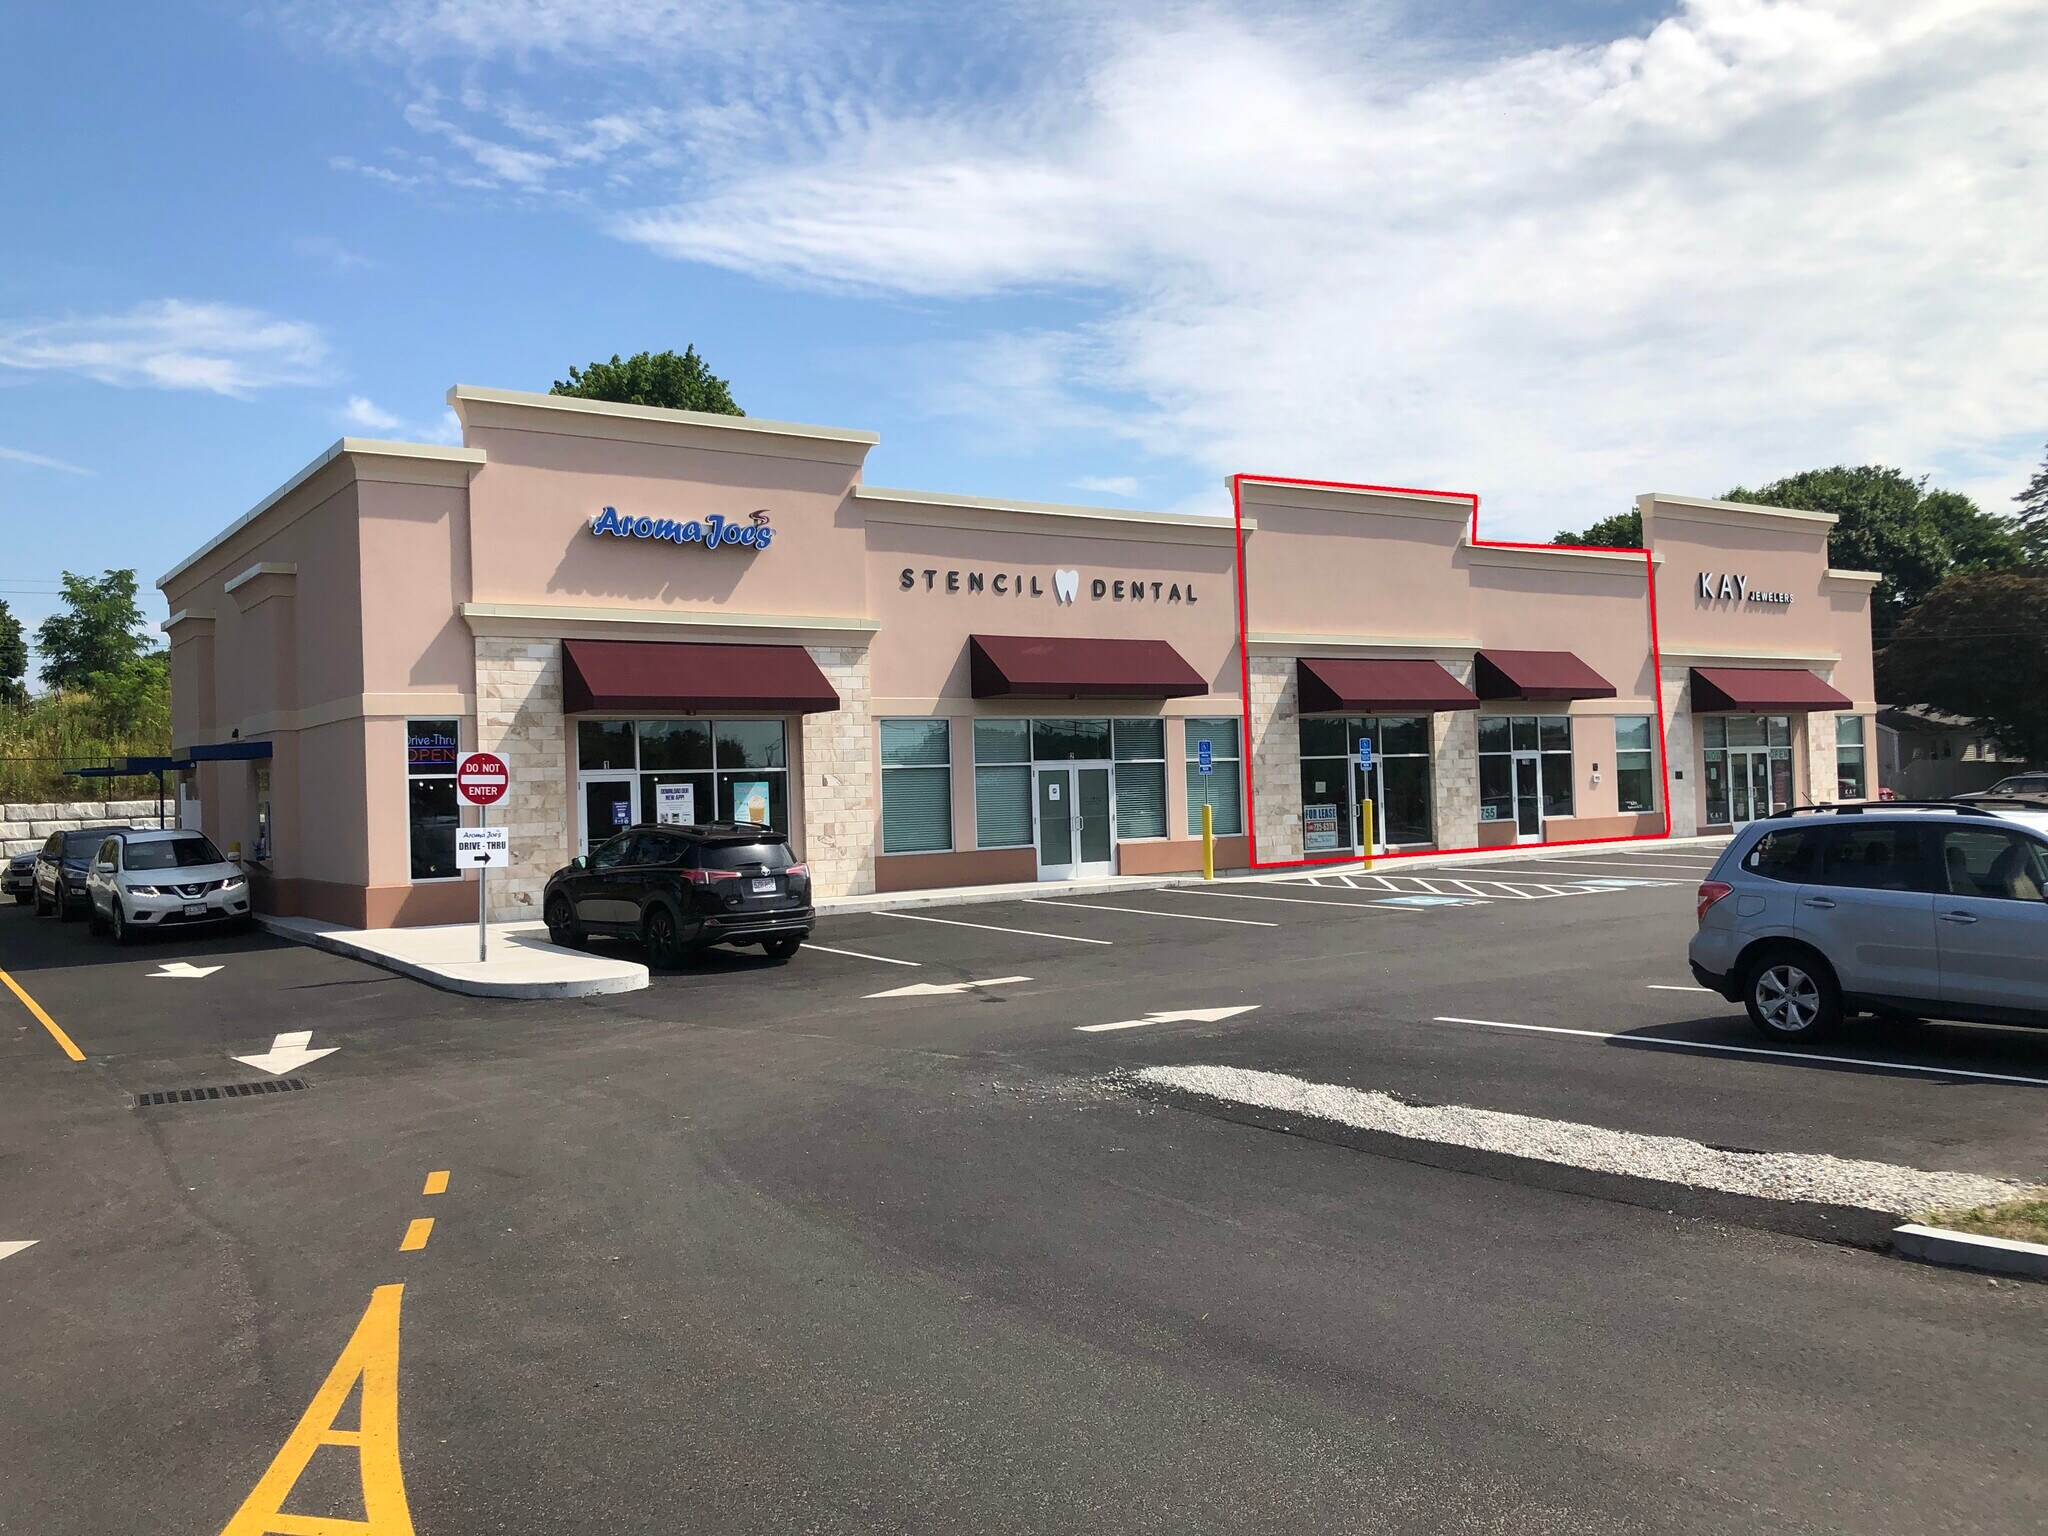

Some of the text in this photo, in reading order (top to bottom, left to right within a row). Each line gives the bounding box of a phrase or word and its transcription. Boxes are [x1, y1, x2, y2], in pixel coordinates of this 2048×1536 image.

[593, 506, 703, 544] Aroma
[901, 568, 1198, 602] STENCIL DENTAL
[1699, 572, 1795, 603] KAY JEWELERS
[408, 749, 456, 762] OPEN
[466, 763, 500, 773] DO NOT
[468, 786, 498, 796] ENTER
[1305, 808, 1336, 820] FOR LEASE
[1480, 807, 1495, 819] 755
[463, 831, 486, 839] Aroma
[458, 841, 481, 851] DRIVE
[486, 841, 507, 850] THRU
